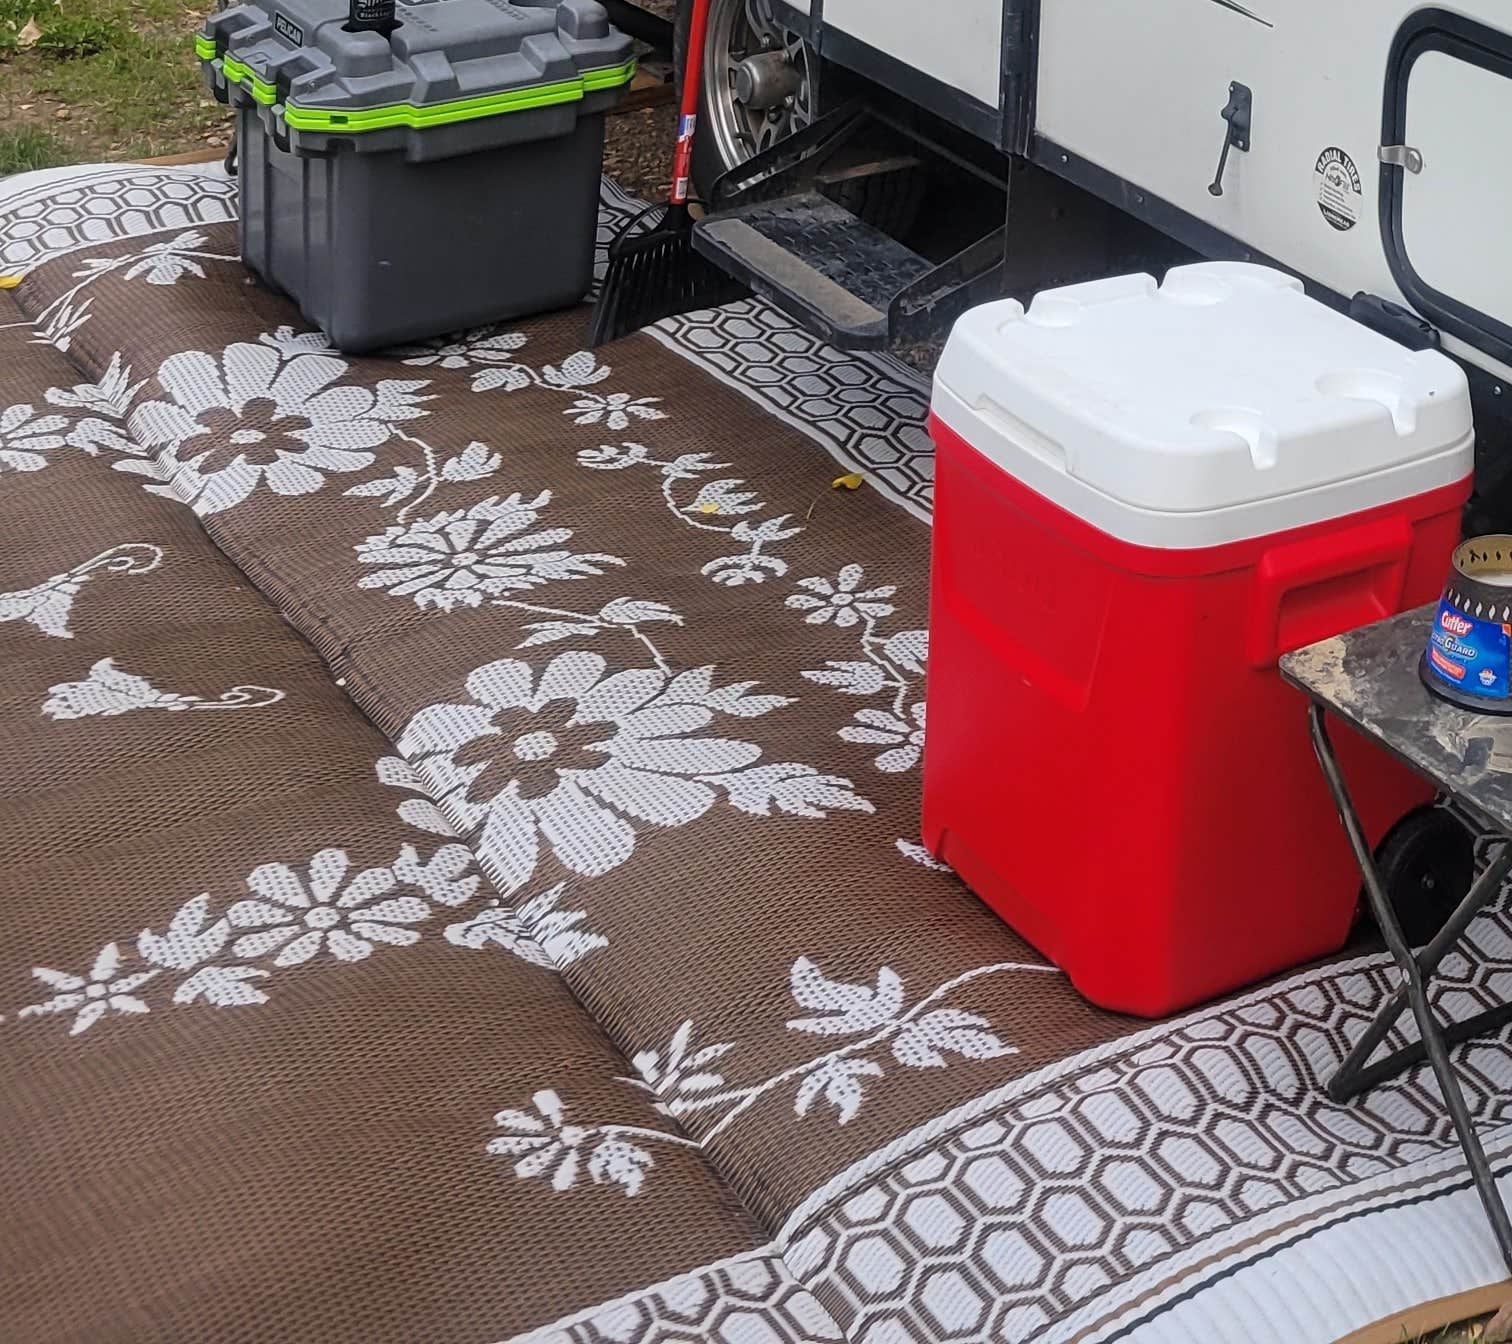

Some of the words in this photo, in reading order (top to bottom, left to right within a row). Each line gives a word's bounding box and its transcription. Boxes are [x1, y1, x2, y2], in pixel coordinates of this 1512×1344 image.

[276, 15, 302, 46] PELICAN
[1316, 149, 1342, 174] RADIAL
[1343, 154, 1361, 192] TIRES
[1441, 610, 1473, 634] Cutter
